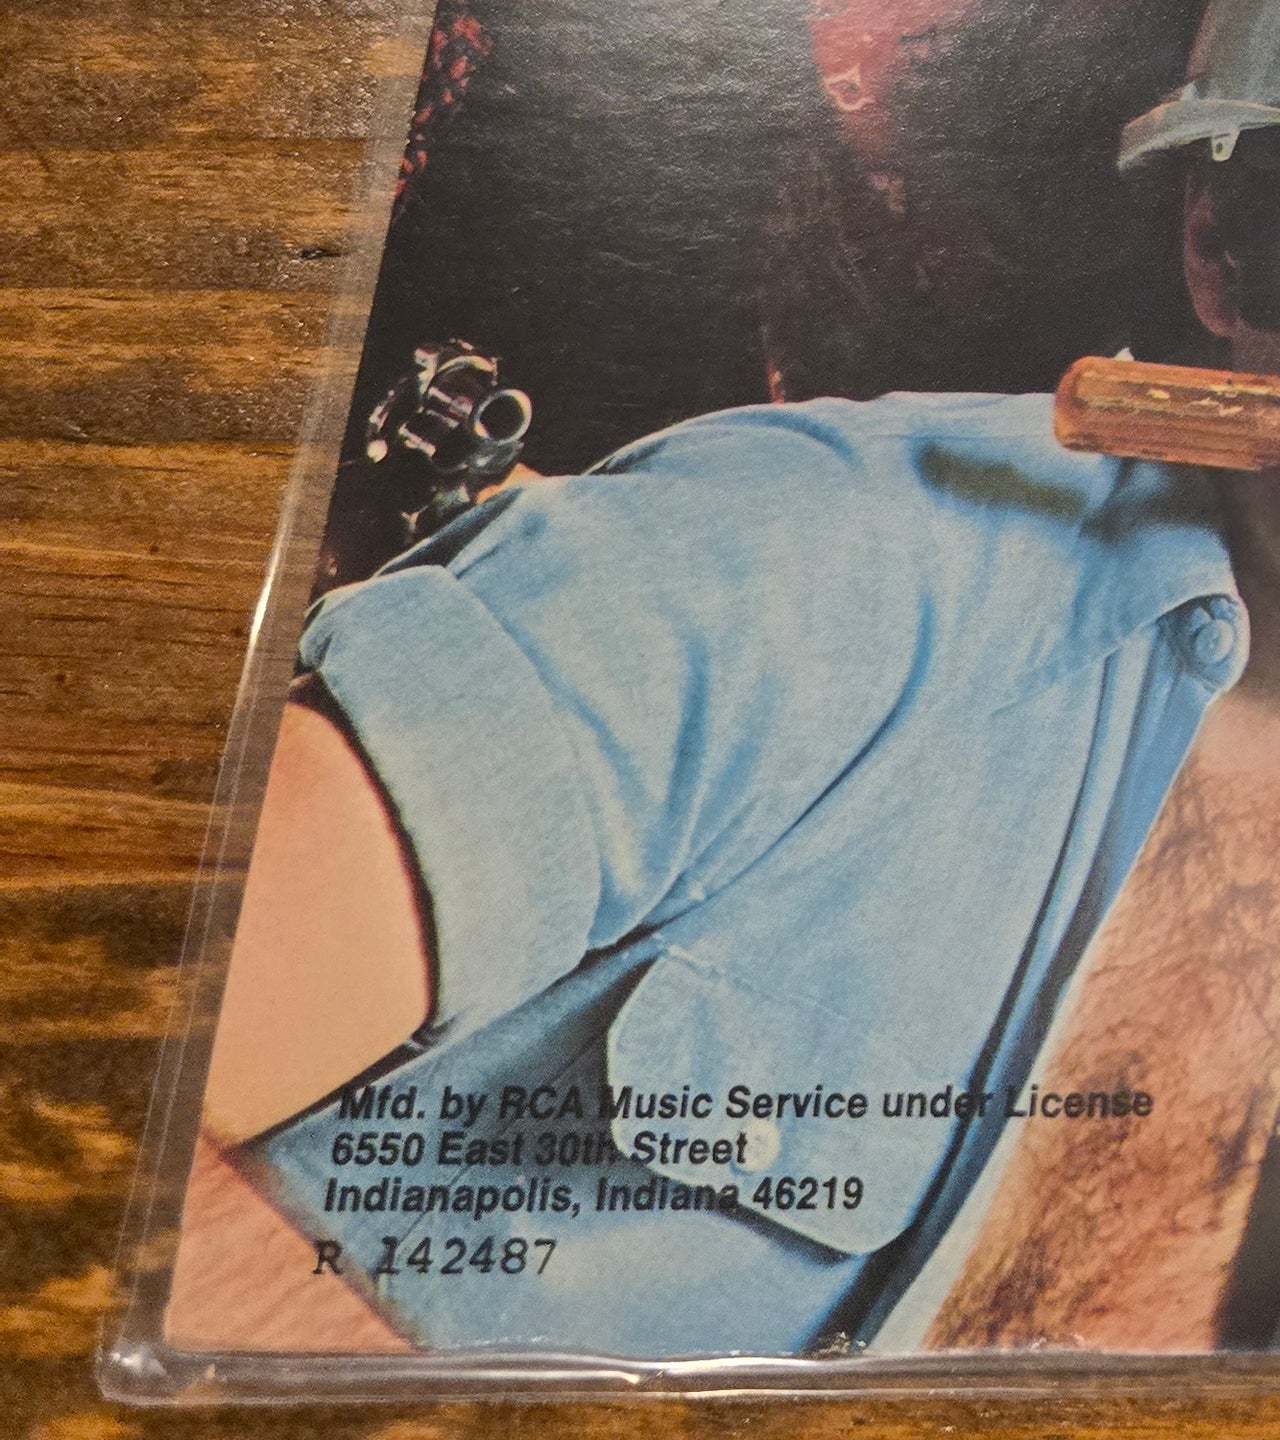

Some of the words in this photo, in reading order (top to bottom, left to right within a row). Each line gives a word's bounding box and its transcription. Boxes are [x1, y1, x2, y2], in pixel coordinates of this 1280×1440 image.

[339, 1086, 425, 1119] Mfd.
[440, 1087, 487, 1127] by
[500, 1086, 584, 1118] RCA
[600, 1085, 712, 1118] Music
[725, 1084, 868, 1119] Service
[883, 1085, 996, 1118] under
[1005, 1085, 1153, 1118] License
[332, 1132, 425, 1166] 6550
[438, 1132, 524, 1165] East
[533, 1131, 617, 1165] 30th
[631, 1130, 748, 1165] Street
[324, 1177, 581, 1221] Indianapolis,
[596, 1176, 740, 1211] Indiana
[753, 1176, 863, 1210] 46219
[314, 1242, 343, 1276] R
[376, 1236, 557, 1277] 142487
